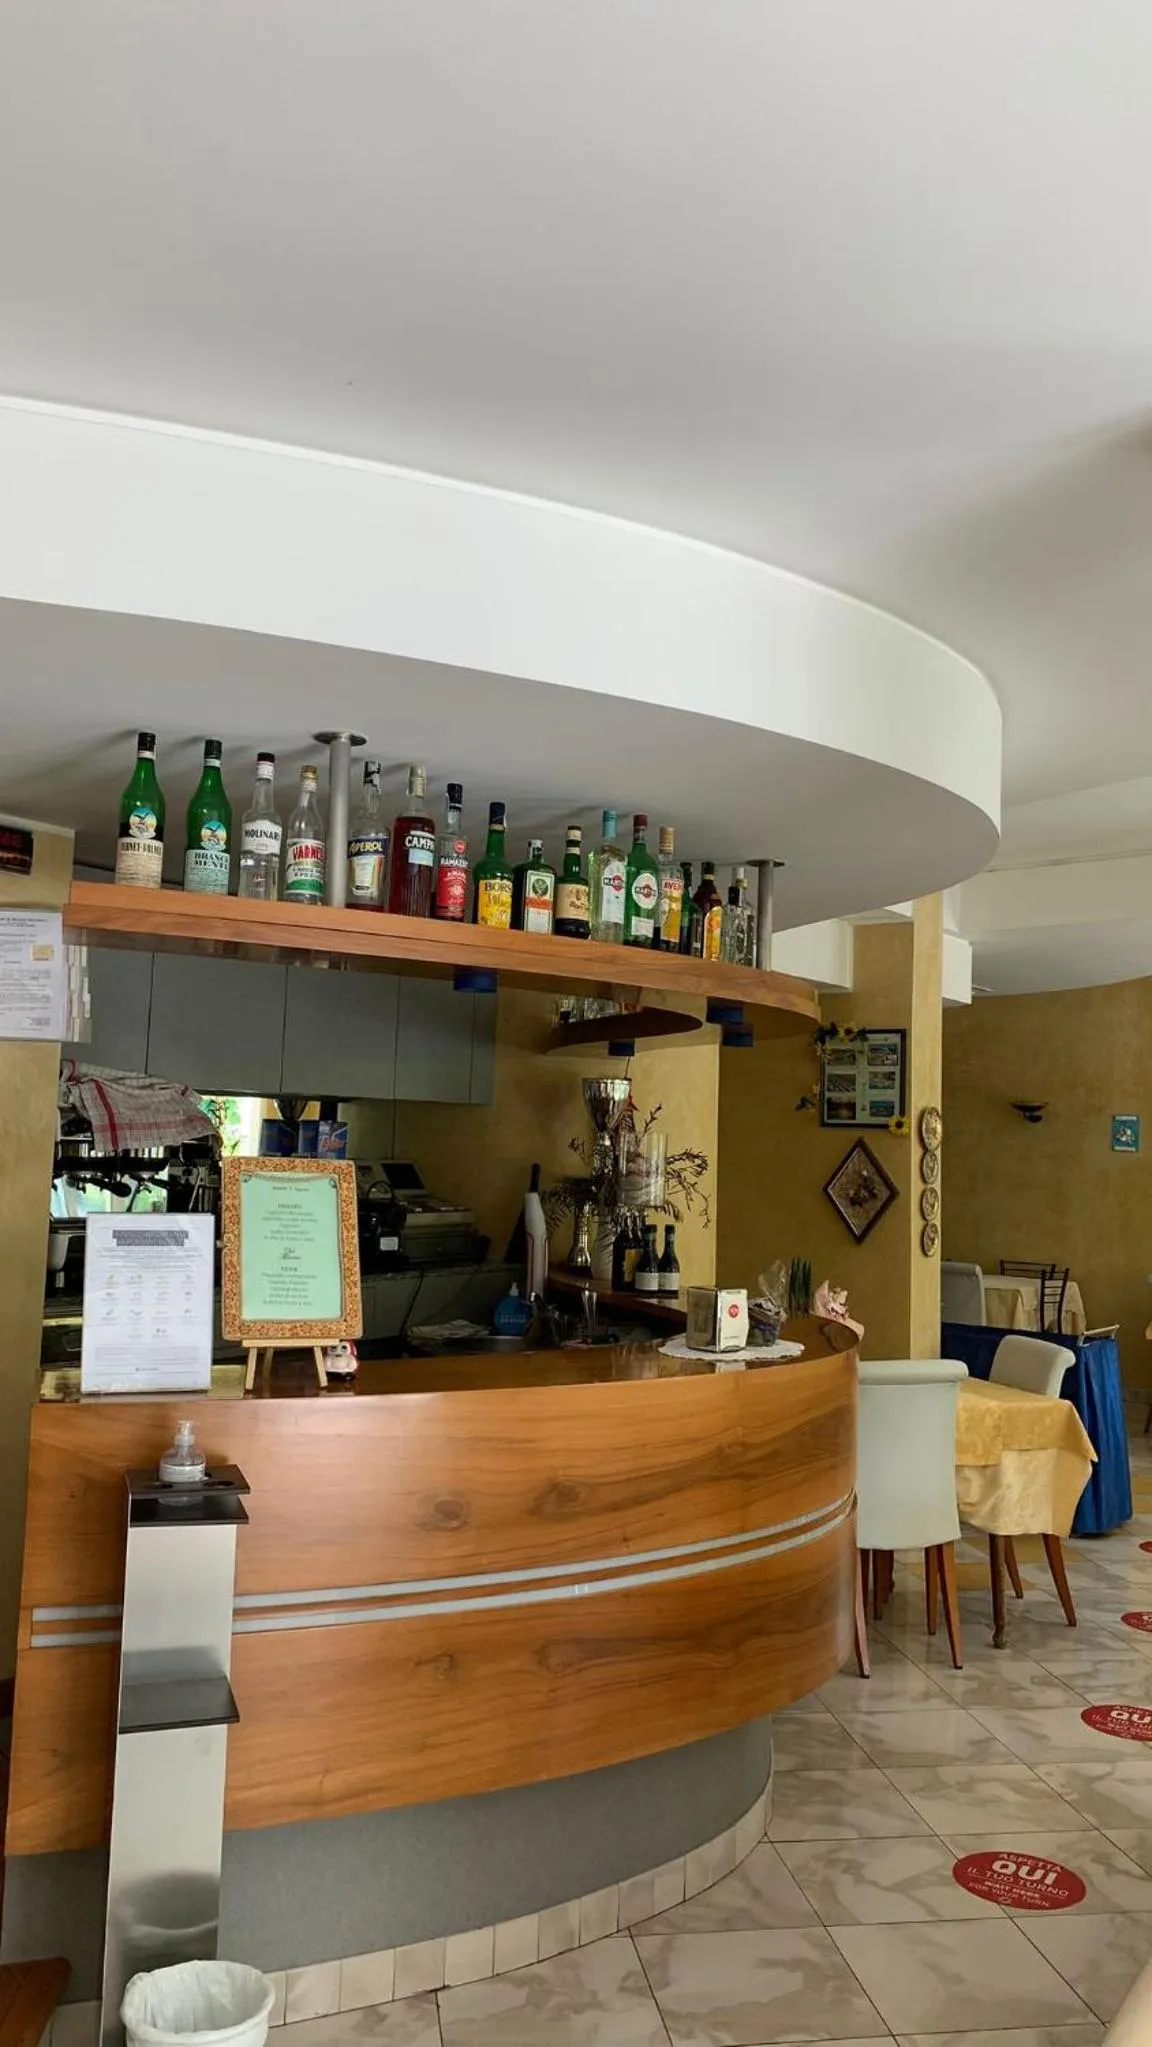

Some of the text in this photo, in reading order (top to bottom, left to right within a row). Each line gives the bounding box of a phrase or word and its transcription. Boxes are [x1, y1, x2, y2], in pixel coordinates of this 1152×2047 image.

[349, 841, 383, 853] APEROL
[992, 1860, 1058, 1885] QUI
[998, 1853, 1062, 1872] ASPETTA
[967, 1866, 1069, 1897] IL TUO TURNO
[985, 1880, 1010, 1890] WAIT
[968, 1882, 1051, 1907] FOR YOUR TURN
